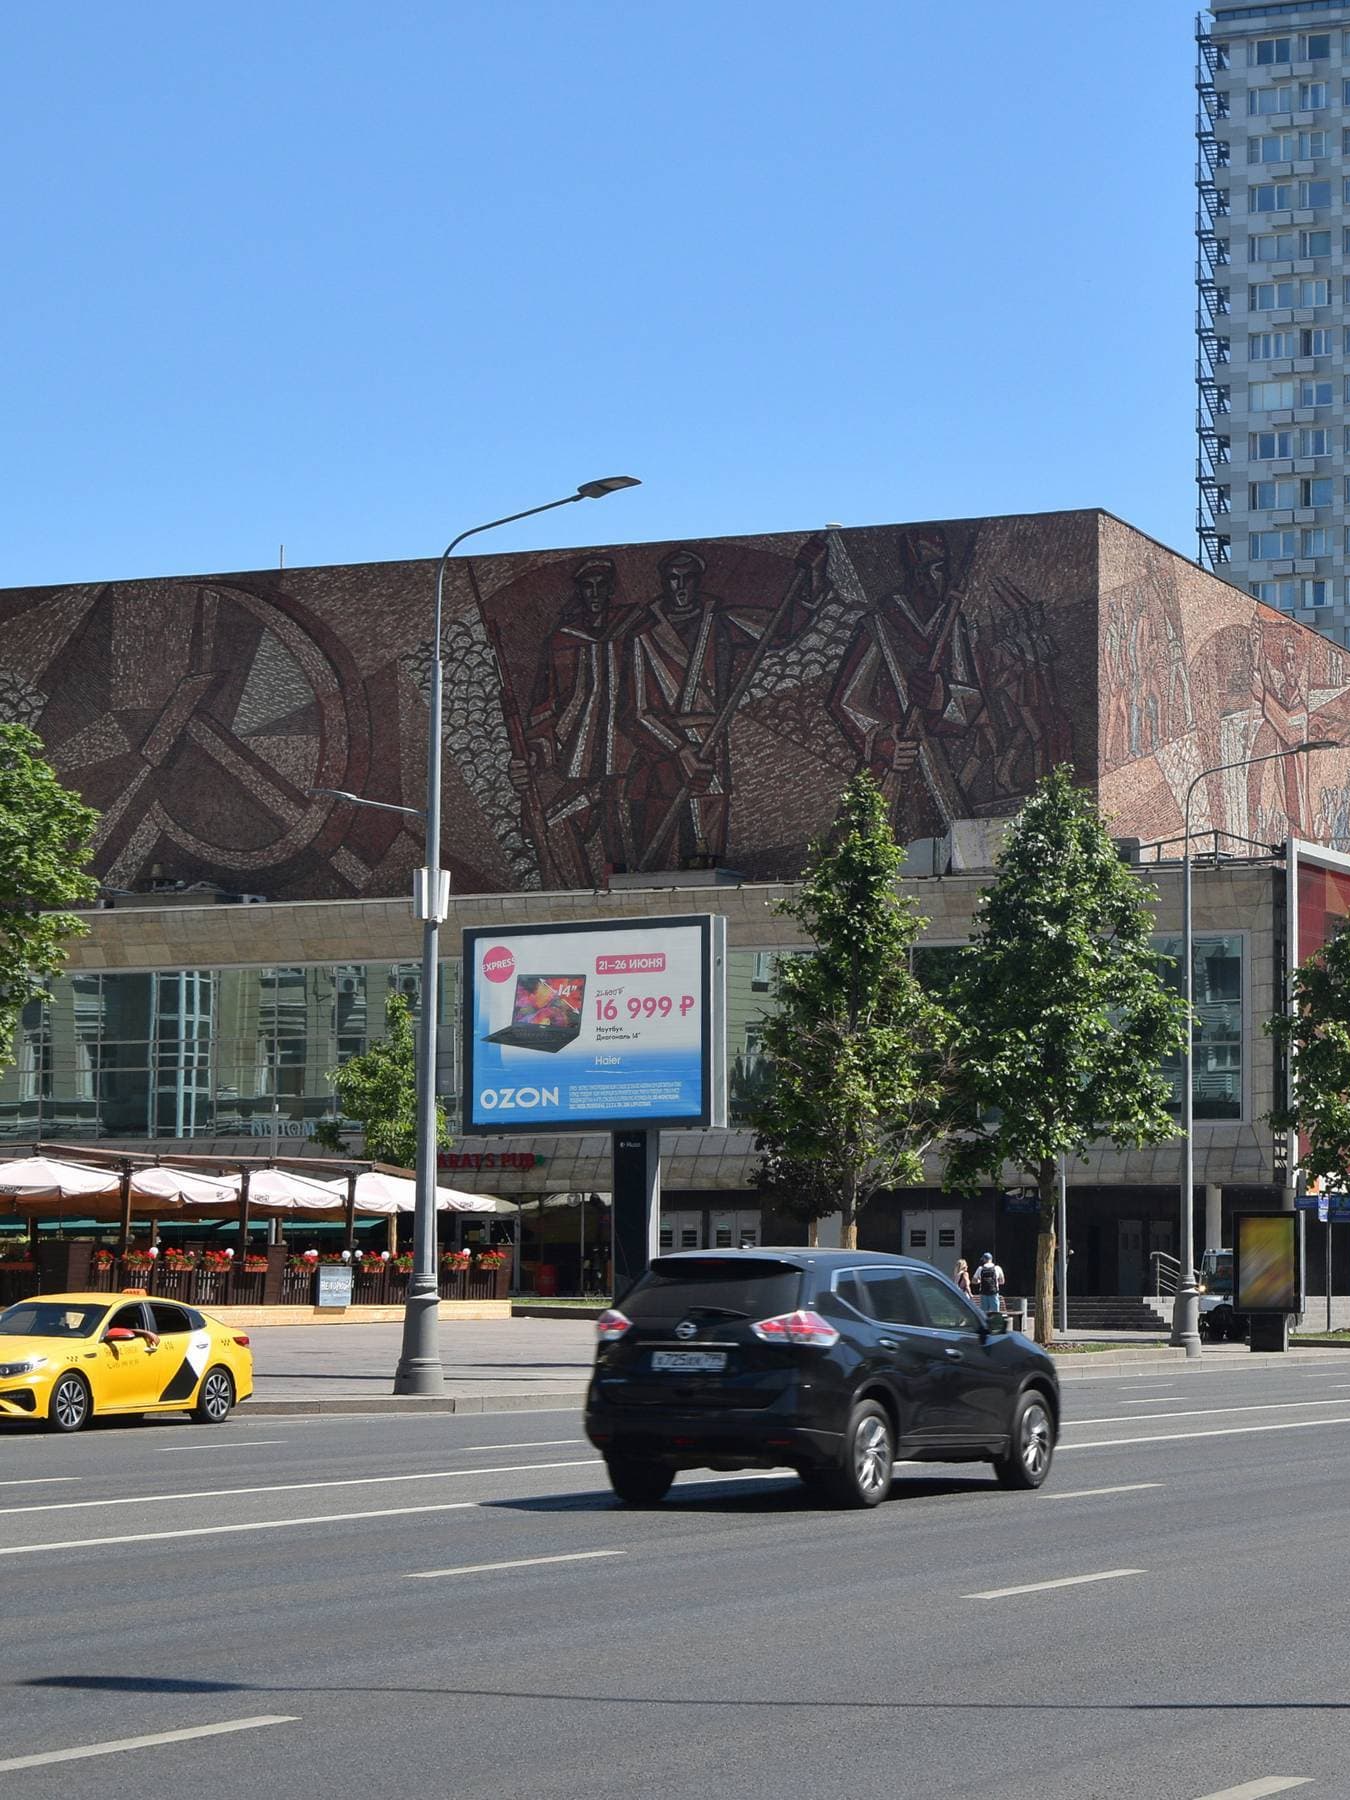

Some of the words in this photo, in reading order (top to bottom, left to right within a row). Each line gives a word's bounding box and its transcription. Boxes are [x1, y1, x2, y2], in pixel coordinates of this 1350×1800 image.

[482, 958, 516, 973] EXPRESS
[629, 958, 663, 969] ИЮНЯ
[596, 998, 618, 1020] 16
[627, 996, 673, 1019] 999
[596, 1026, 623, 1035] Ноутбук
[595, 1055, 622, 1065] Haier
[480, 1086, 559, 1109] OZON
